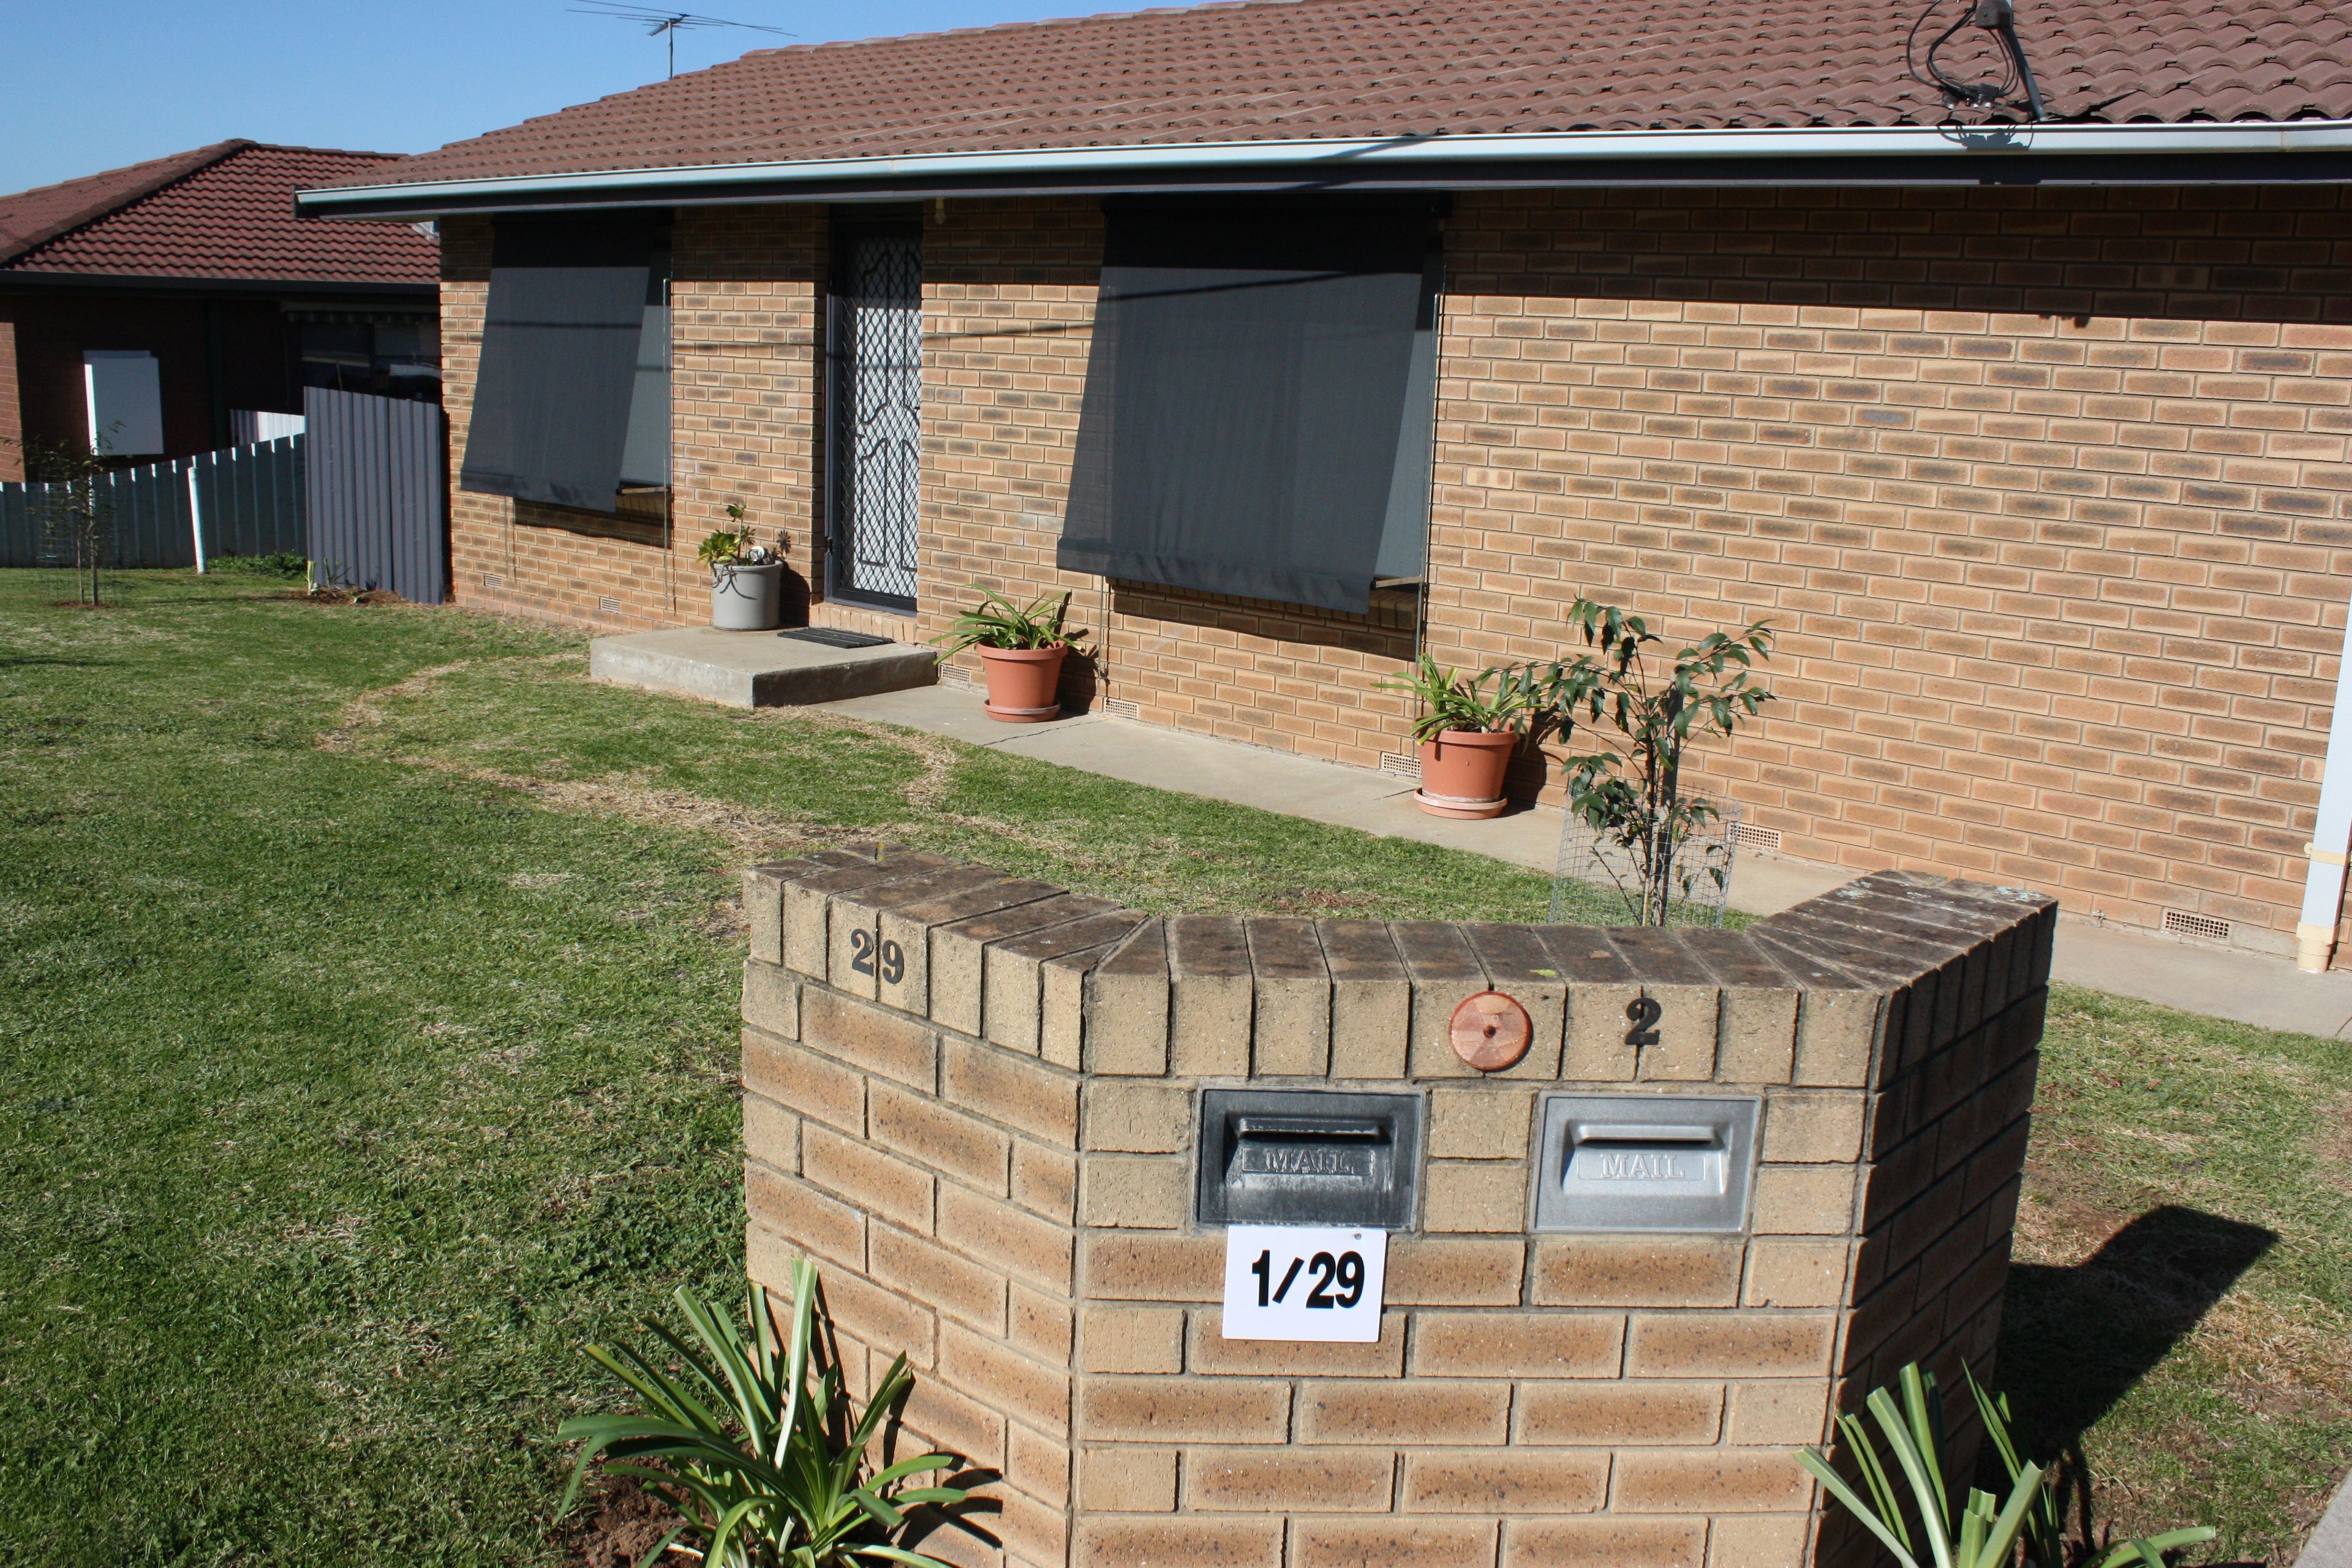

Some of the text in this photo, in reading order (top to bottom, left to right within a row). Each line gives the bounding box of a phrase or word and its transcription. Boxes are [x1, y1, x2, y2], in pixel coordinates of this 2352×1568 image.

[851, 929, 904, 984] 29
[1625, 998, 1661, 1045] 2
[1266, 1148, 1353, 1174] MAIL
[1600, 1153, 1686, 1179] MAIL
[1251, 1250, 1365, 1309] 1/29
